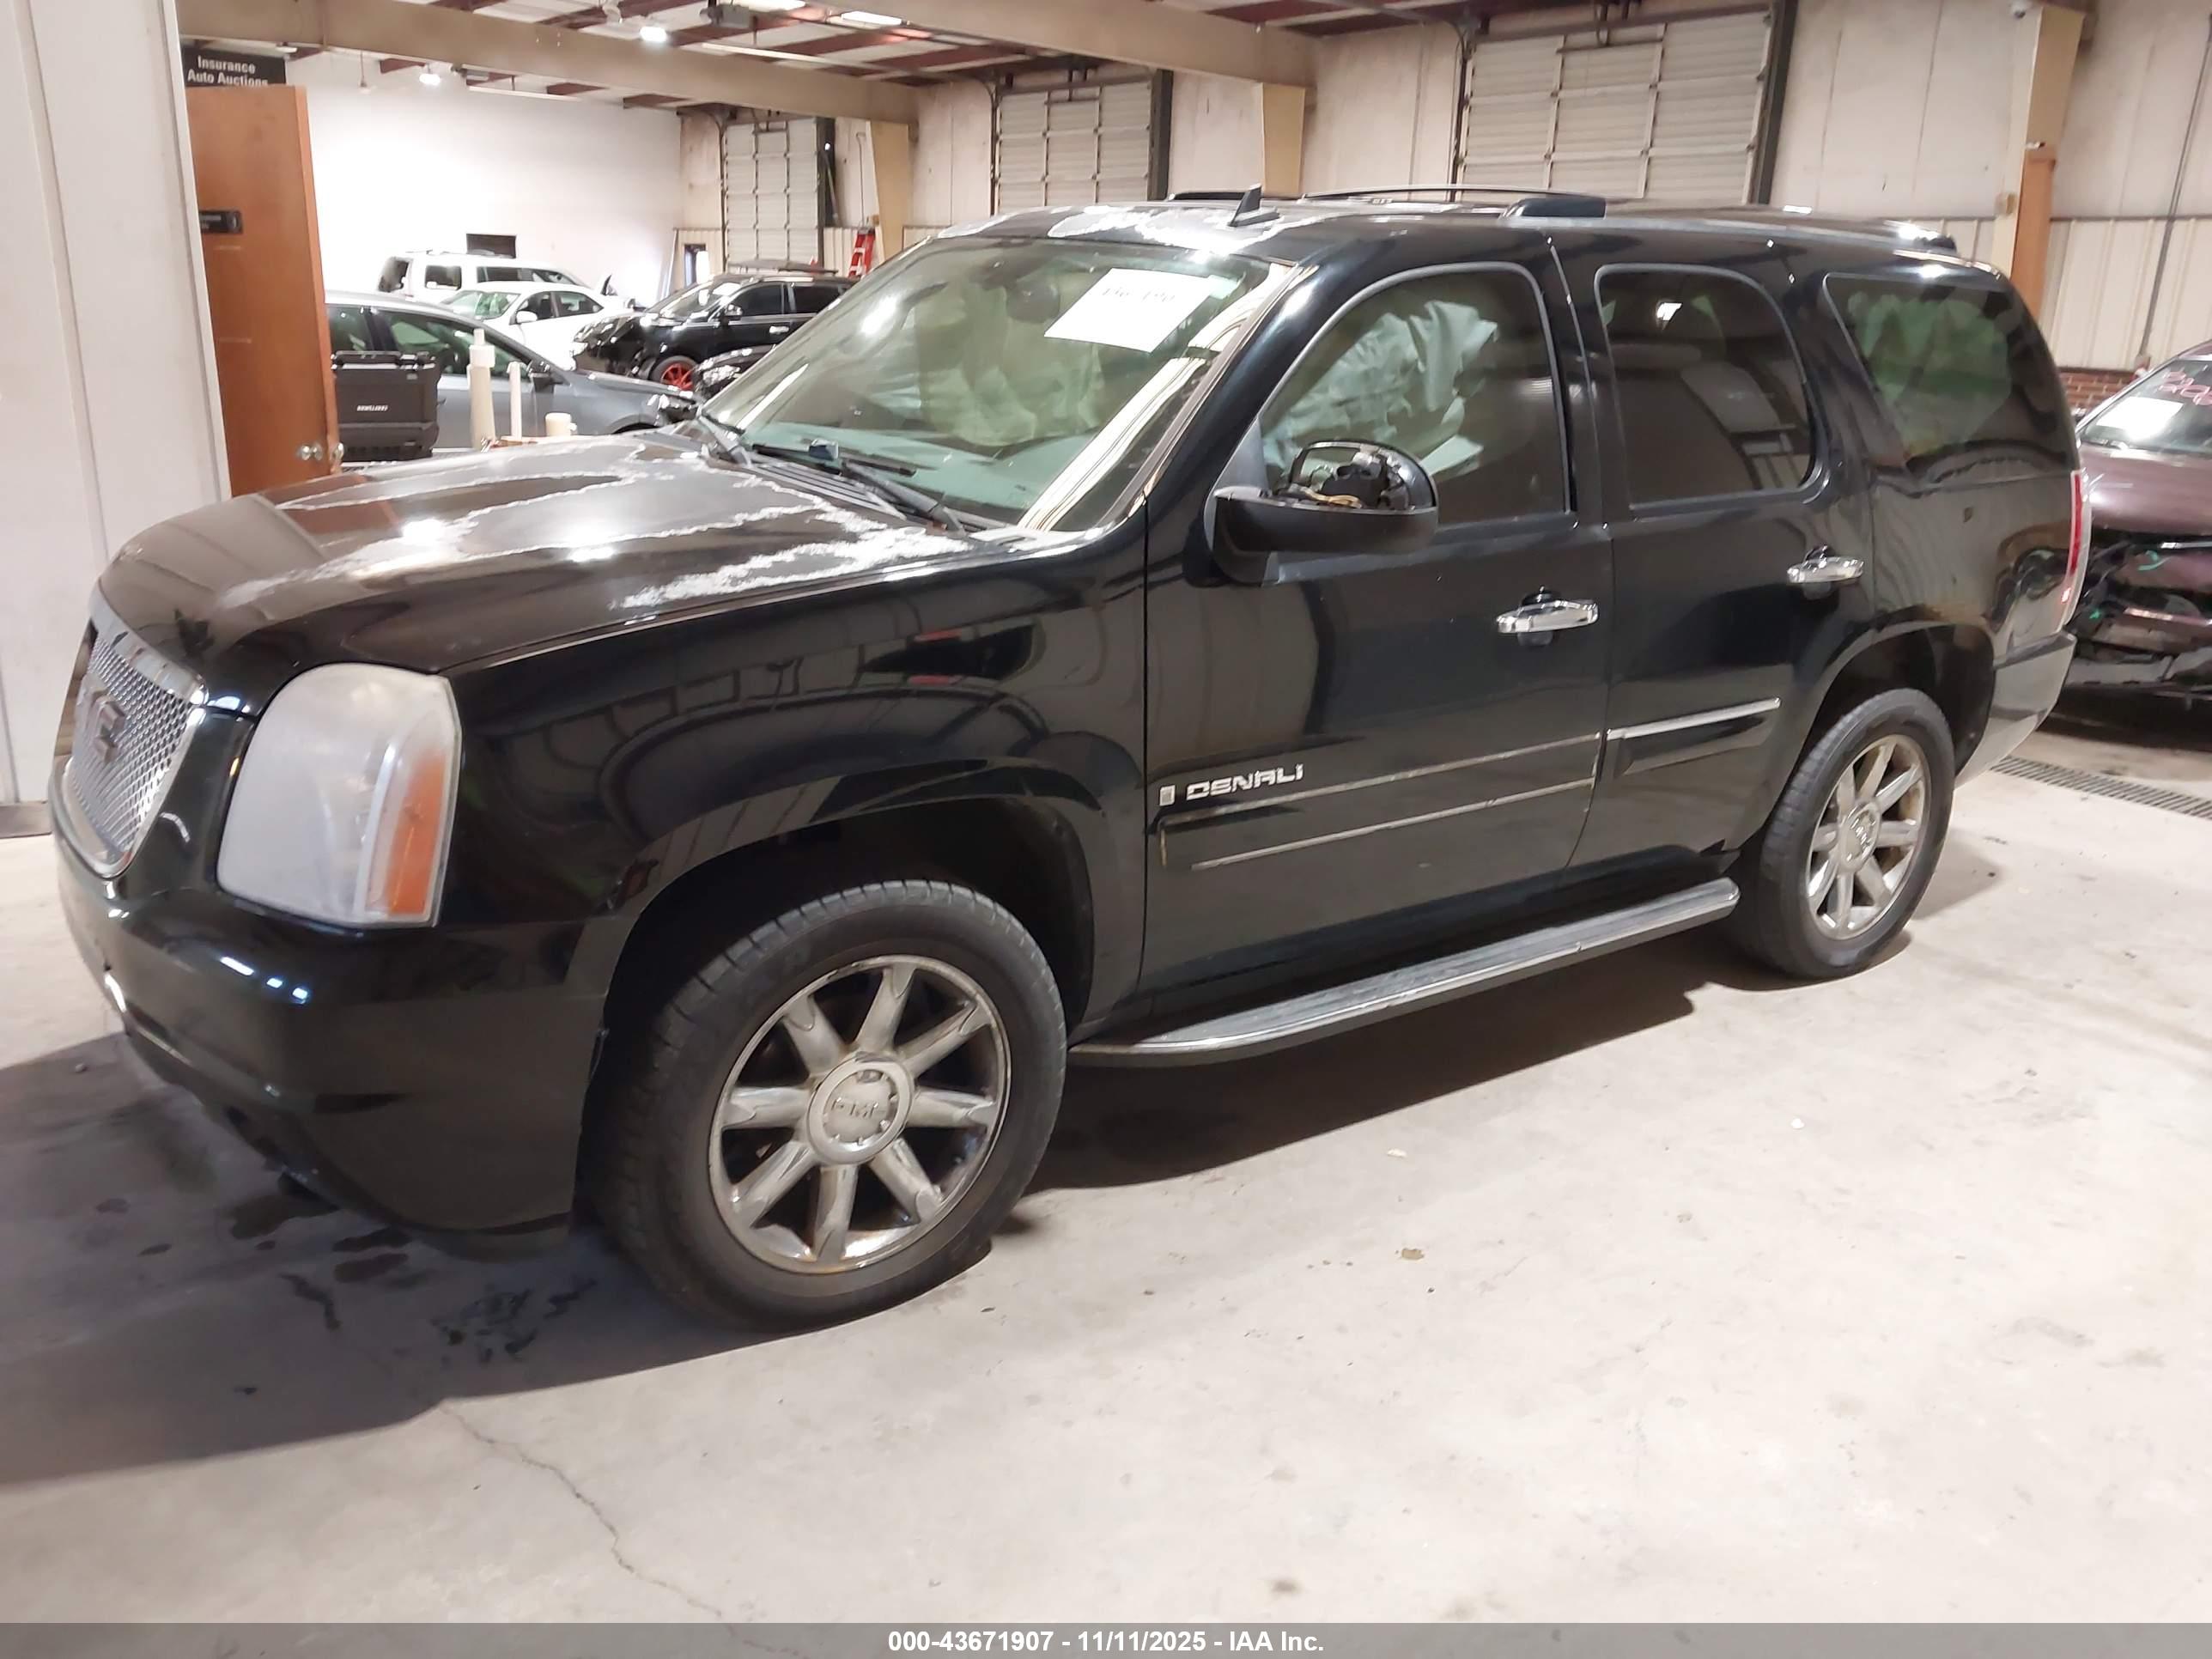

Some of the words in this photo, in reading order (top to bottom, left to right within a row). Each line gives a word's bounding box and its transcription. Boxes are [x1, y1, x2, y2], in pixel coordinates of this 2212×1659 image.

[198, 55, 256, 74] Insurance
[187, 69, 215, 83] Auto
[217, 72, 269, 86] Auctions
[1186, 763, 1304, 800] DENALI
